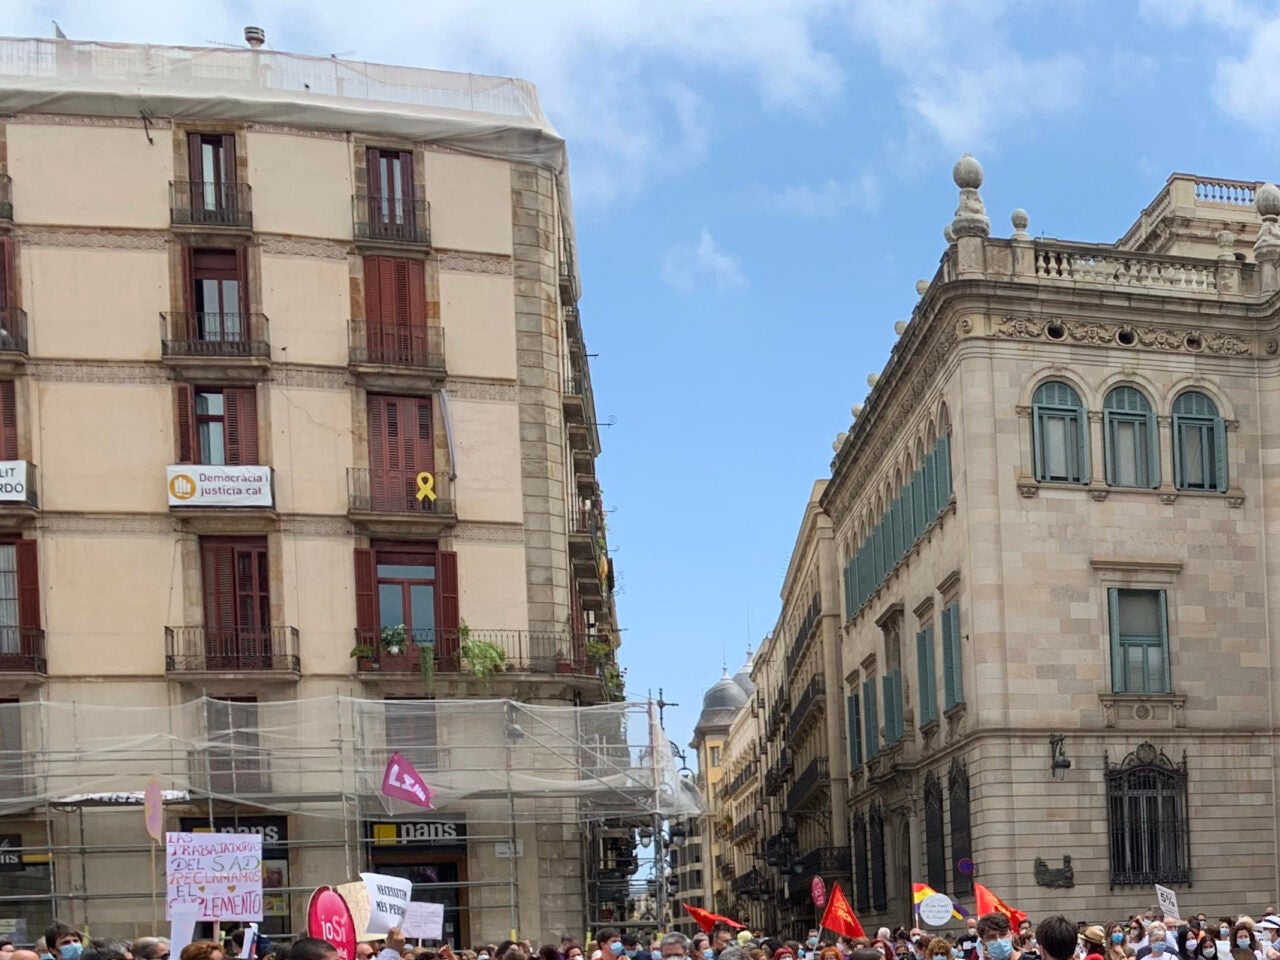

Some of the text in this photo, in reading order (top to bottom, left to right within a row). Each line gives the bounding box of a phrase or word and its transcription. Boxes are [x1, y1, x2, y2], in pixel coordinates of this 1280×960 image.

[199, 472, 263, 483] Democràcia
[401, 822, 457, 844] pans
[171, 855, 260, 872] DEL SAD
[169, 871, 261, 885] RECLAMAMOS
[176, 884, 197, 898] EL
